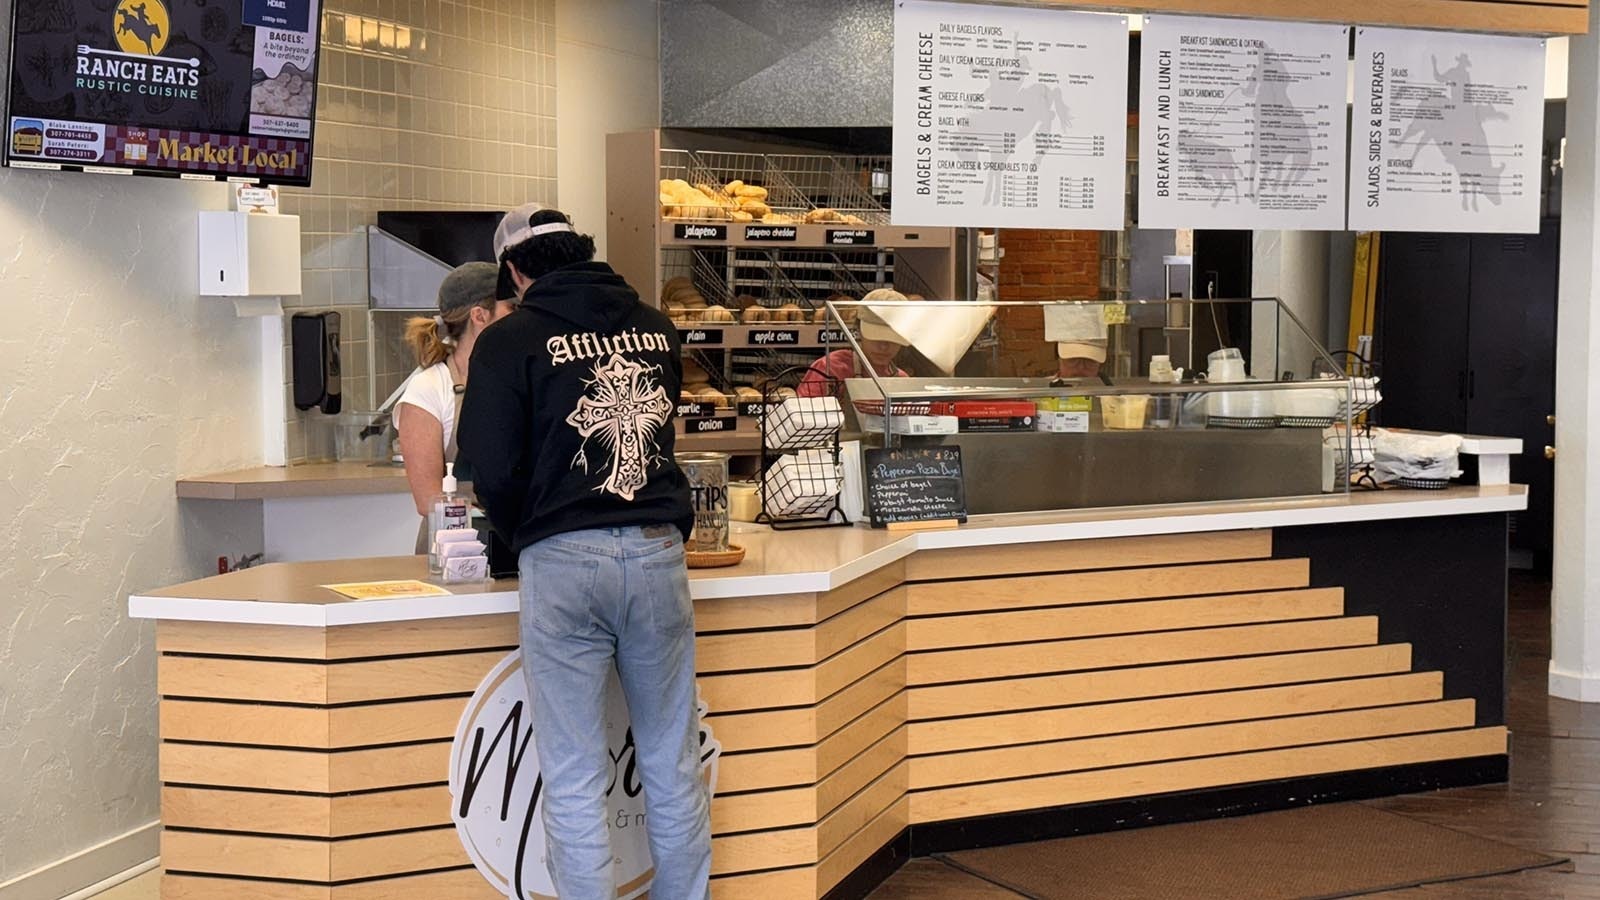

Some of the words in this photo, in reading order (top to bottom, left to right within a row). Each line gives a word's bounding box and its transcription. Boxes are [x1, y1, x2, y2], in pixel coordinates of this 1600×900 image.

[940, 23, 955, 33] DAILY
[957, 24, 977, 35] BAGELS
[978, 25, 1003, 37] FLAVORS
[269, 31, 304, 45] BAGELS:
[1180, 35, 1208, 46] BREAKFAST
[1209, 37, 1239, 47] SANDWICHES
[1244, 39, 1264, 49] OATMEAL
[270, 43, 283, 52] bite
[285, 45, 309, 56] beyond
[919, 32, 933, 80] CHEESE
[265, 51, 277, 59] the
[278, 53, 306, 64] ordinary
[939, 54, 954, 64] DAILY
[956, 55, 973, 65] CREAM
[975, 57, 995, 66] CHEESE
[996, 58, 1020, 68] FLAVORS
[76, 57, 149, 82] RANCH
[152, 65, 200, 87] EATS
[1159, 50, 1171, 90] LUNCH
[76, 78, 131, 93] RUSTIC
[138, 85, 198, 100] CUISINE
[1371, 51, 1385, 116] BEVERAGES
[939, 91, 958, 101] CHEESE
[960, 93, 985, 103] FLAVORS
[1179, 88, 1195, 98] LUNCH
[1196, 89, 1225, 99] SANDWICHES
[918, 86, 932, 128] CREAM
[1158, 95, 1170, 120] AND
[939, 116, 955, 126] BAGEL
[957, 117, 970, 127] WITH
[1371, 119, 1383, 128] &
[128, 130, 146, 138] SHOP
[918, 134, 931, 143] &
[1369, 130, 1382, 162] SIDES
[157, 138, 237, 166] Market
[242, 145, 297, 170] Local
[937, 160, 955, 170] CREAM
[956, 160, 976, 171] CHEESE
[983, 162, 1020, 172] SPREADABLES
[1022, 163, 1029, 172] TO
[1030, 163, 1038, 173] GO
[1157, 125, 1170, 198] BREAKFAST
[917, 147, 931, 196] BAGELS
[684, 225, 717, 239] jalapeno
[746, 227, 771, 239] jalapeno
[772, 226, 796, 238] cheddar
[686, 331, 706, 345] plain
[754, 331, 775, 345] apple
[776, 331, 794, 343] cinn.
[546, 327, 671, 366] Affliction
[677, 402, 701, 415] garlic
[698, 419, 723, 432] onion
[878, 463, 916, 479] Pepperoni
[916, 461, 939, 475] Pizza
[900, 481, 908, 490] of
[910, 480, 933, 492] bagel
[690, 484, 728, 512] TIPS
[616, 809, 629, 829] &
